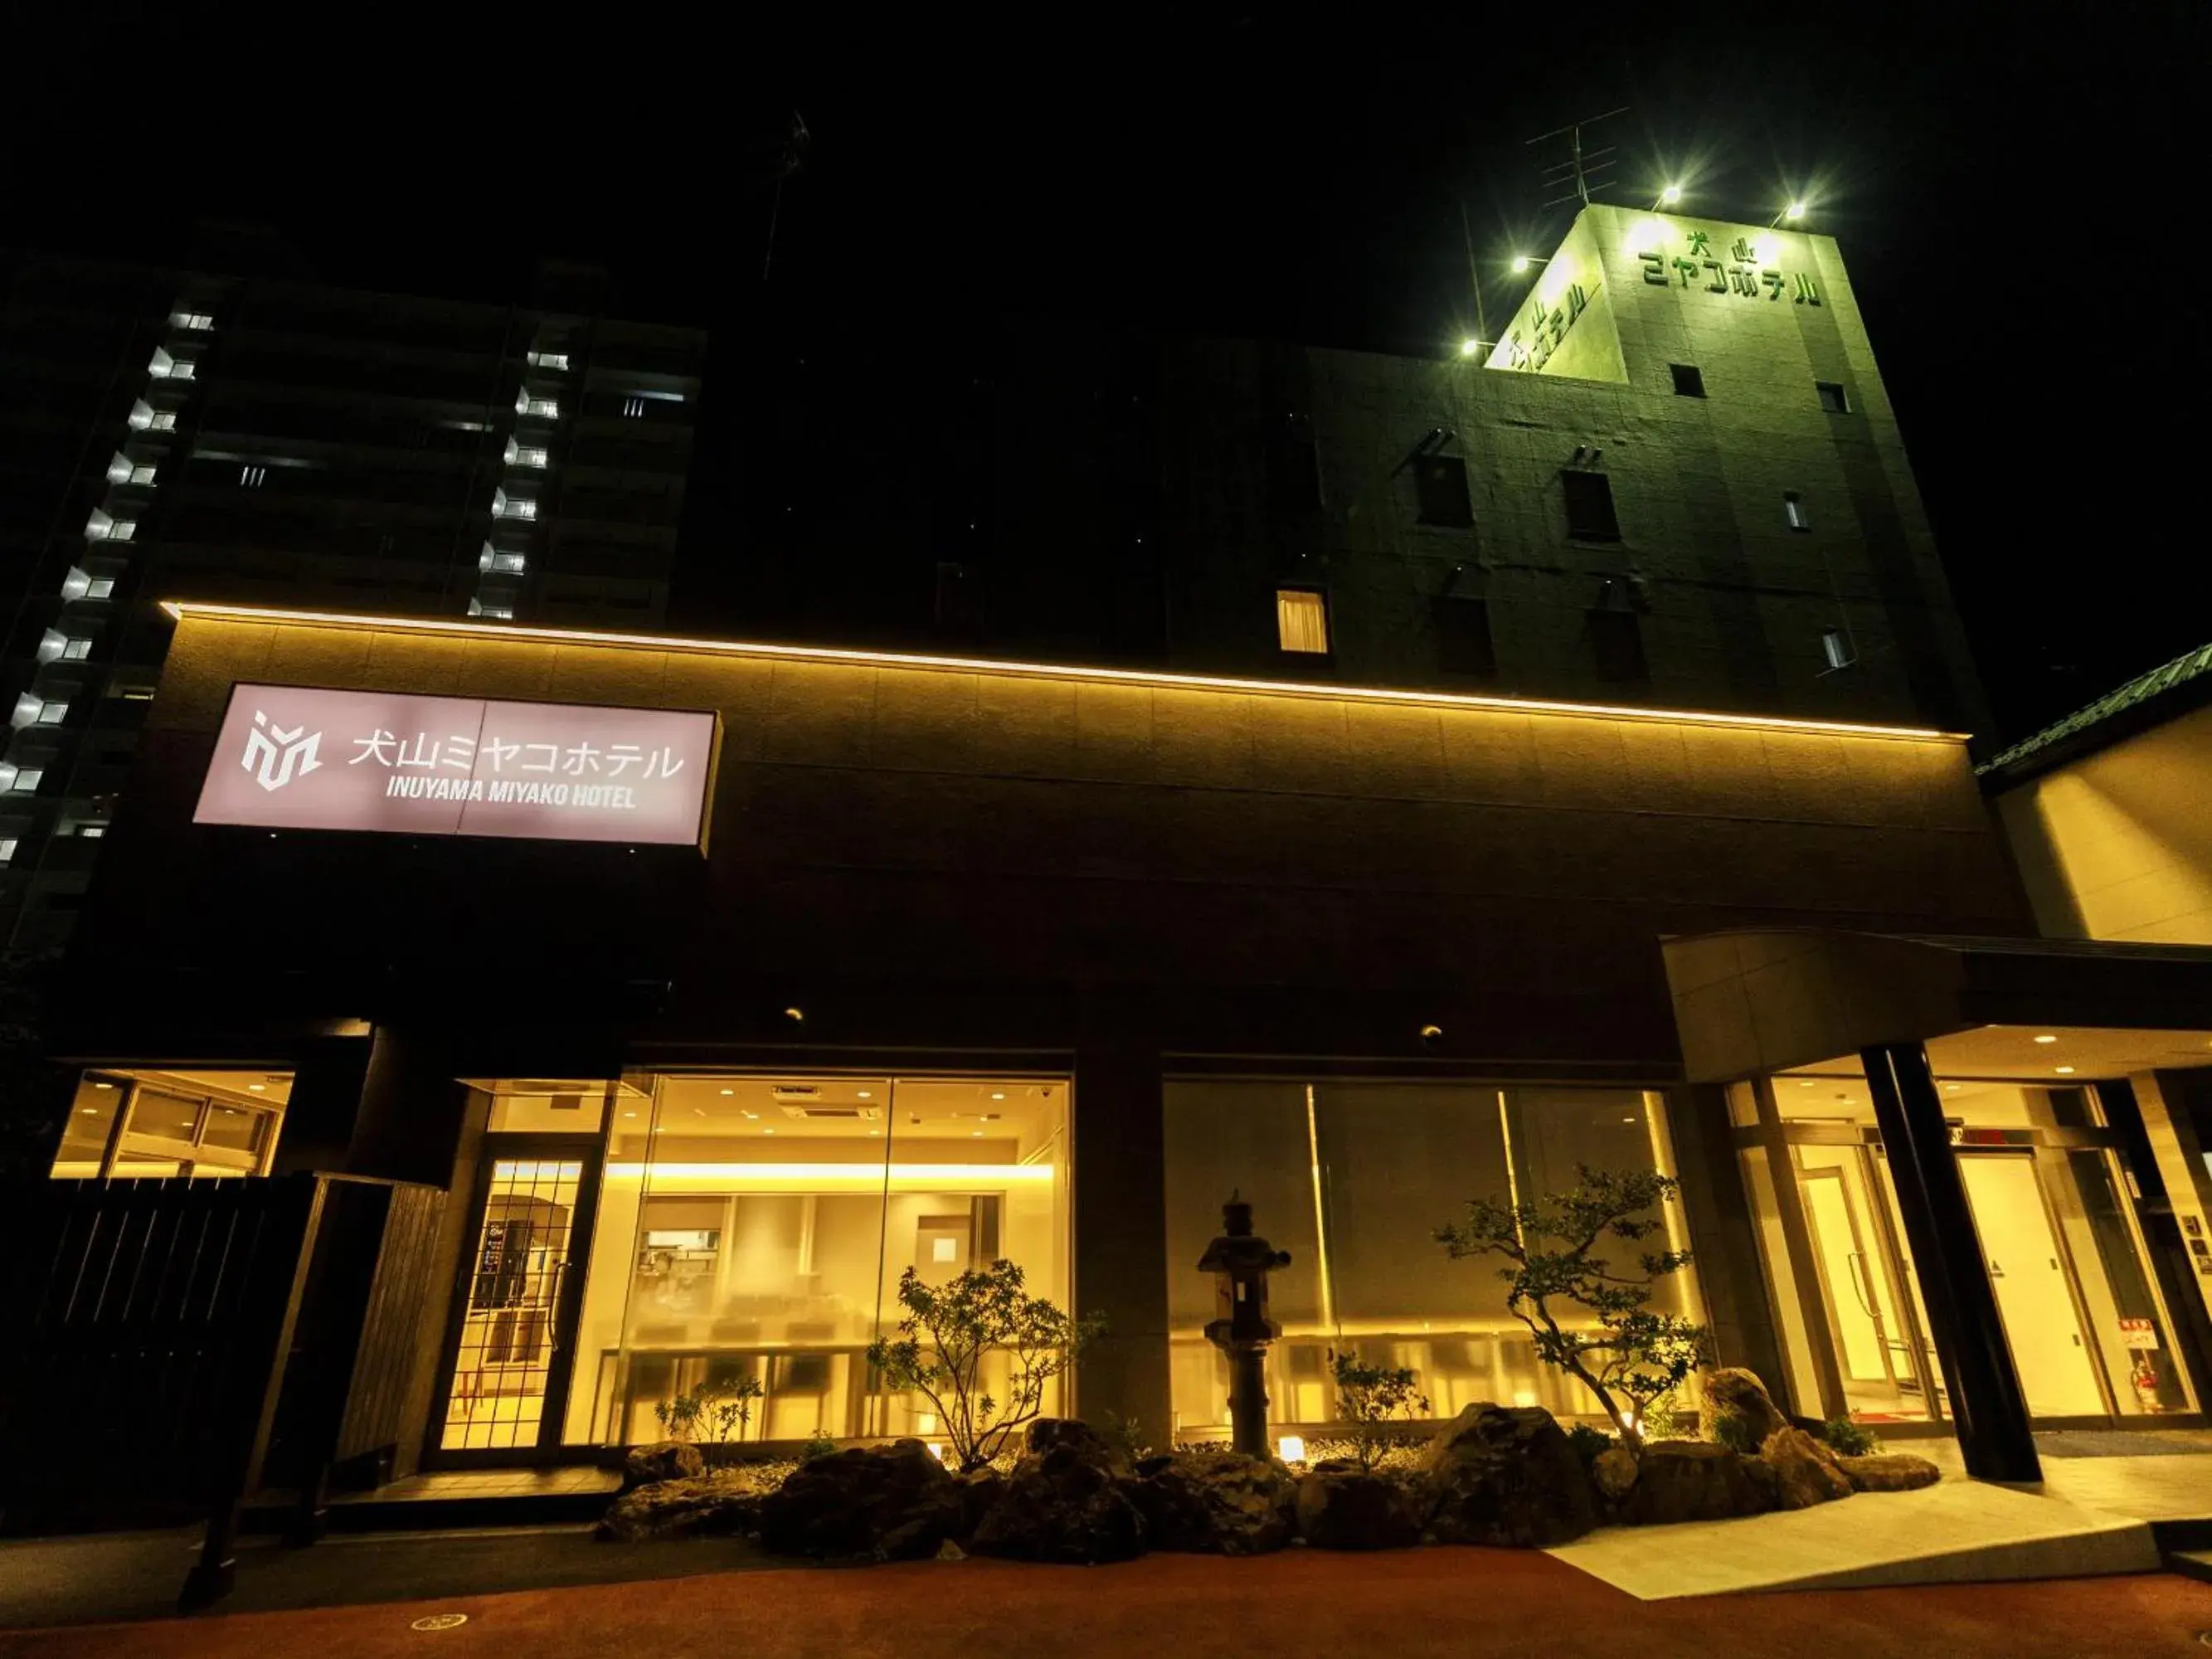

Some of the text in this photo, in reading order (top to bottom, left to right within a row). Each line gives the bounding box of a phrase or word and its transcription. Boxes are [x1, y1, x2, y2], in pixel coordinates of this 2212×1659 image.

[1686, 231, 1757, 264] 犬山
[1638, 251, 1822, 307] ミヤコホテル
[348, 728, 685, 779] 犬山ミヤコホテル
[386, 775, 637, 809] INUYAMA MIYAKO HOTEL
